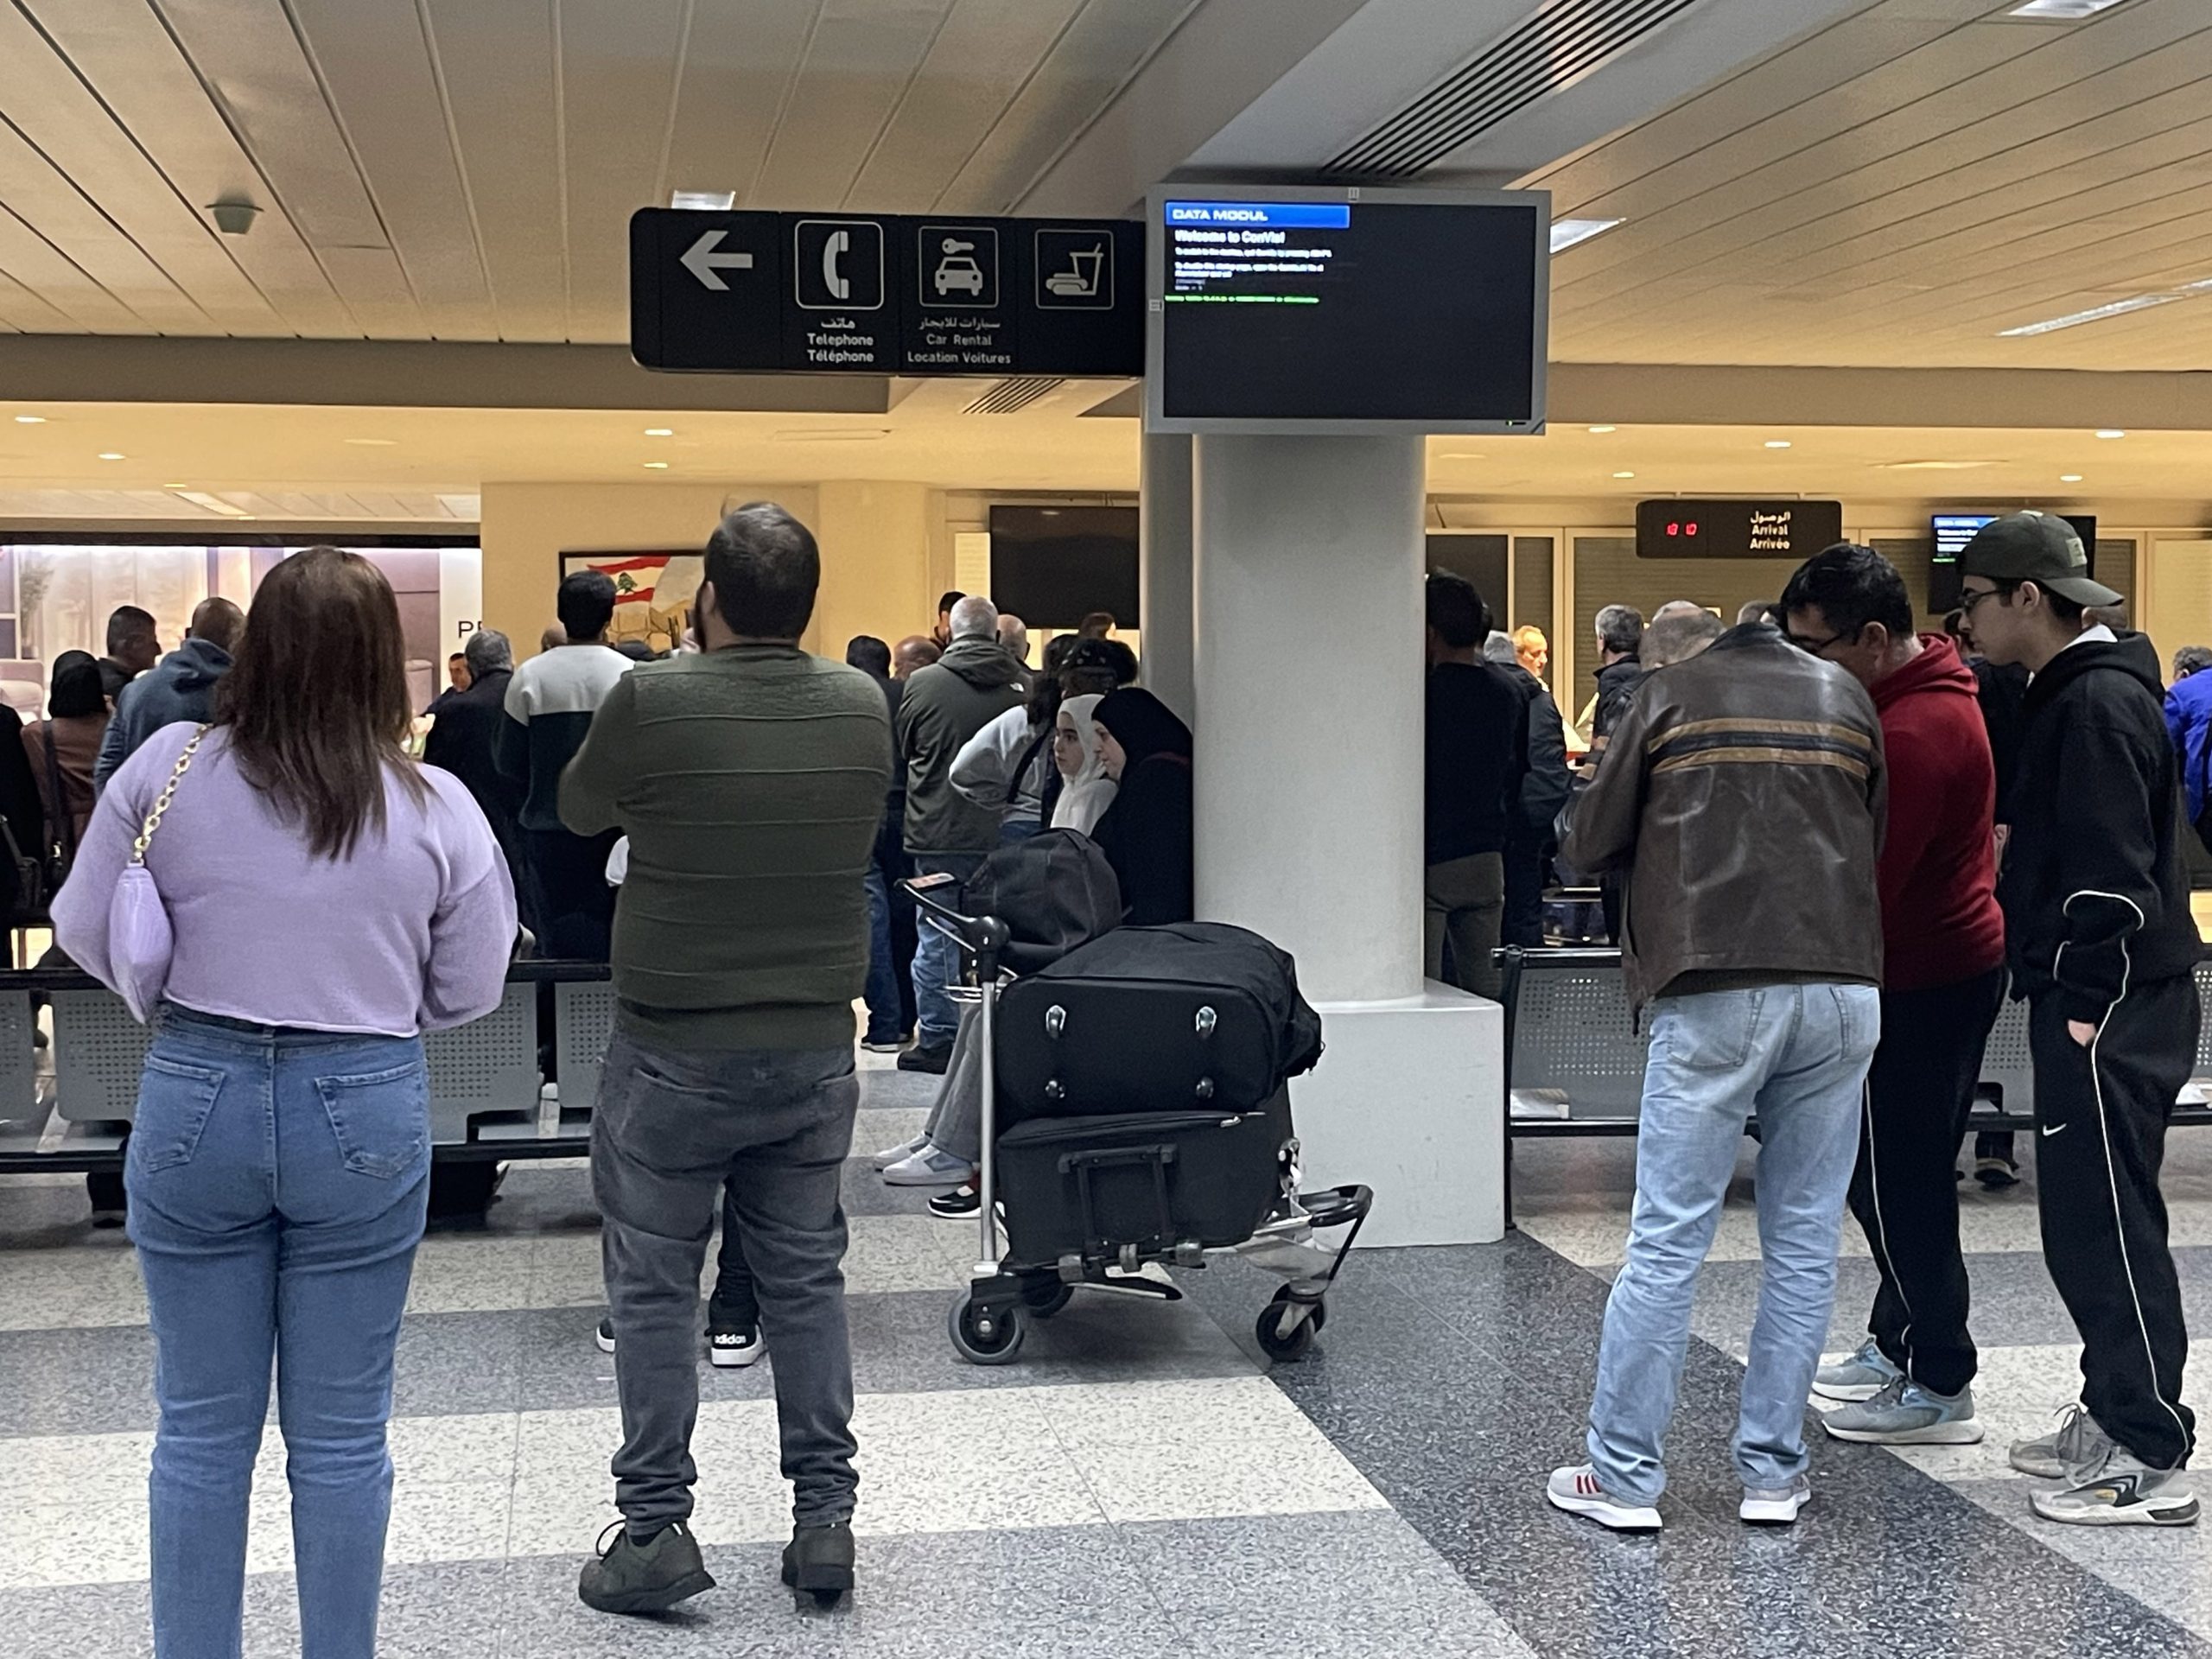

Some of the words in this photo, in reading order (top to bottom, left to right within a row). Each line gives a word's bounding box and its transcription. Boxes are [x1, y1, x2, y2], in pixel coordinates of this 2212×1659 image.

[1172, 208, 1211, 220] DATA
[959, 317, 1001, 331] سيارات
[806, 333, 874, 347] Telephone
[925, 334, 948, 346] Car
[953, 334, 993, 346] Rental
[806, 349, 874, 364] Téléphone
[907, 350, 959, 364] Location
[962, 351, 1012, 365] Voitures
[1750, 511, 1791, 524] الوصول
[1751, 524, 1789, 536] Arrival
[1749, 537, 1791, 550] Arrivée
[714, 1333, 747, 1344] adidas
